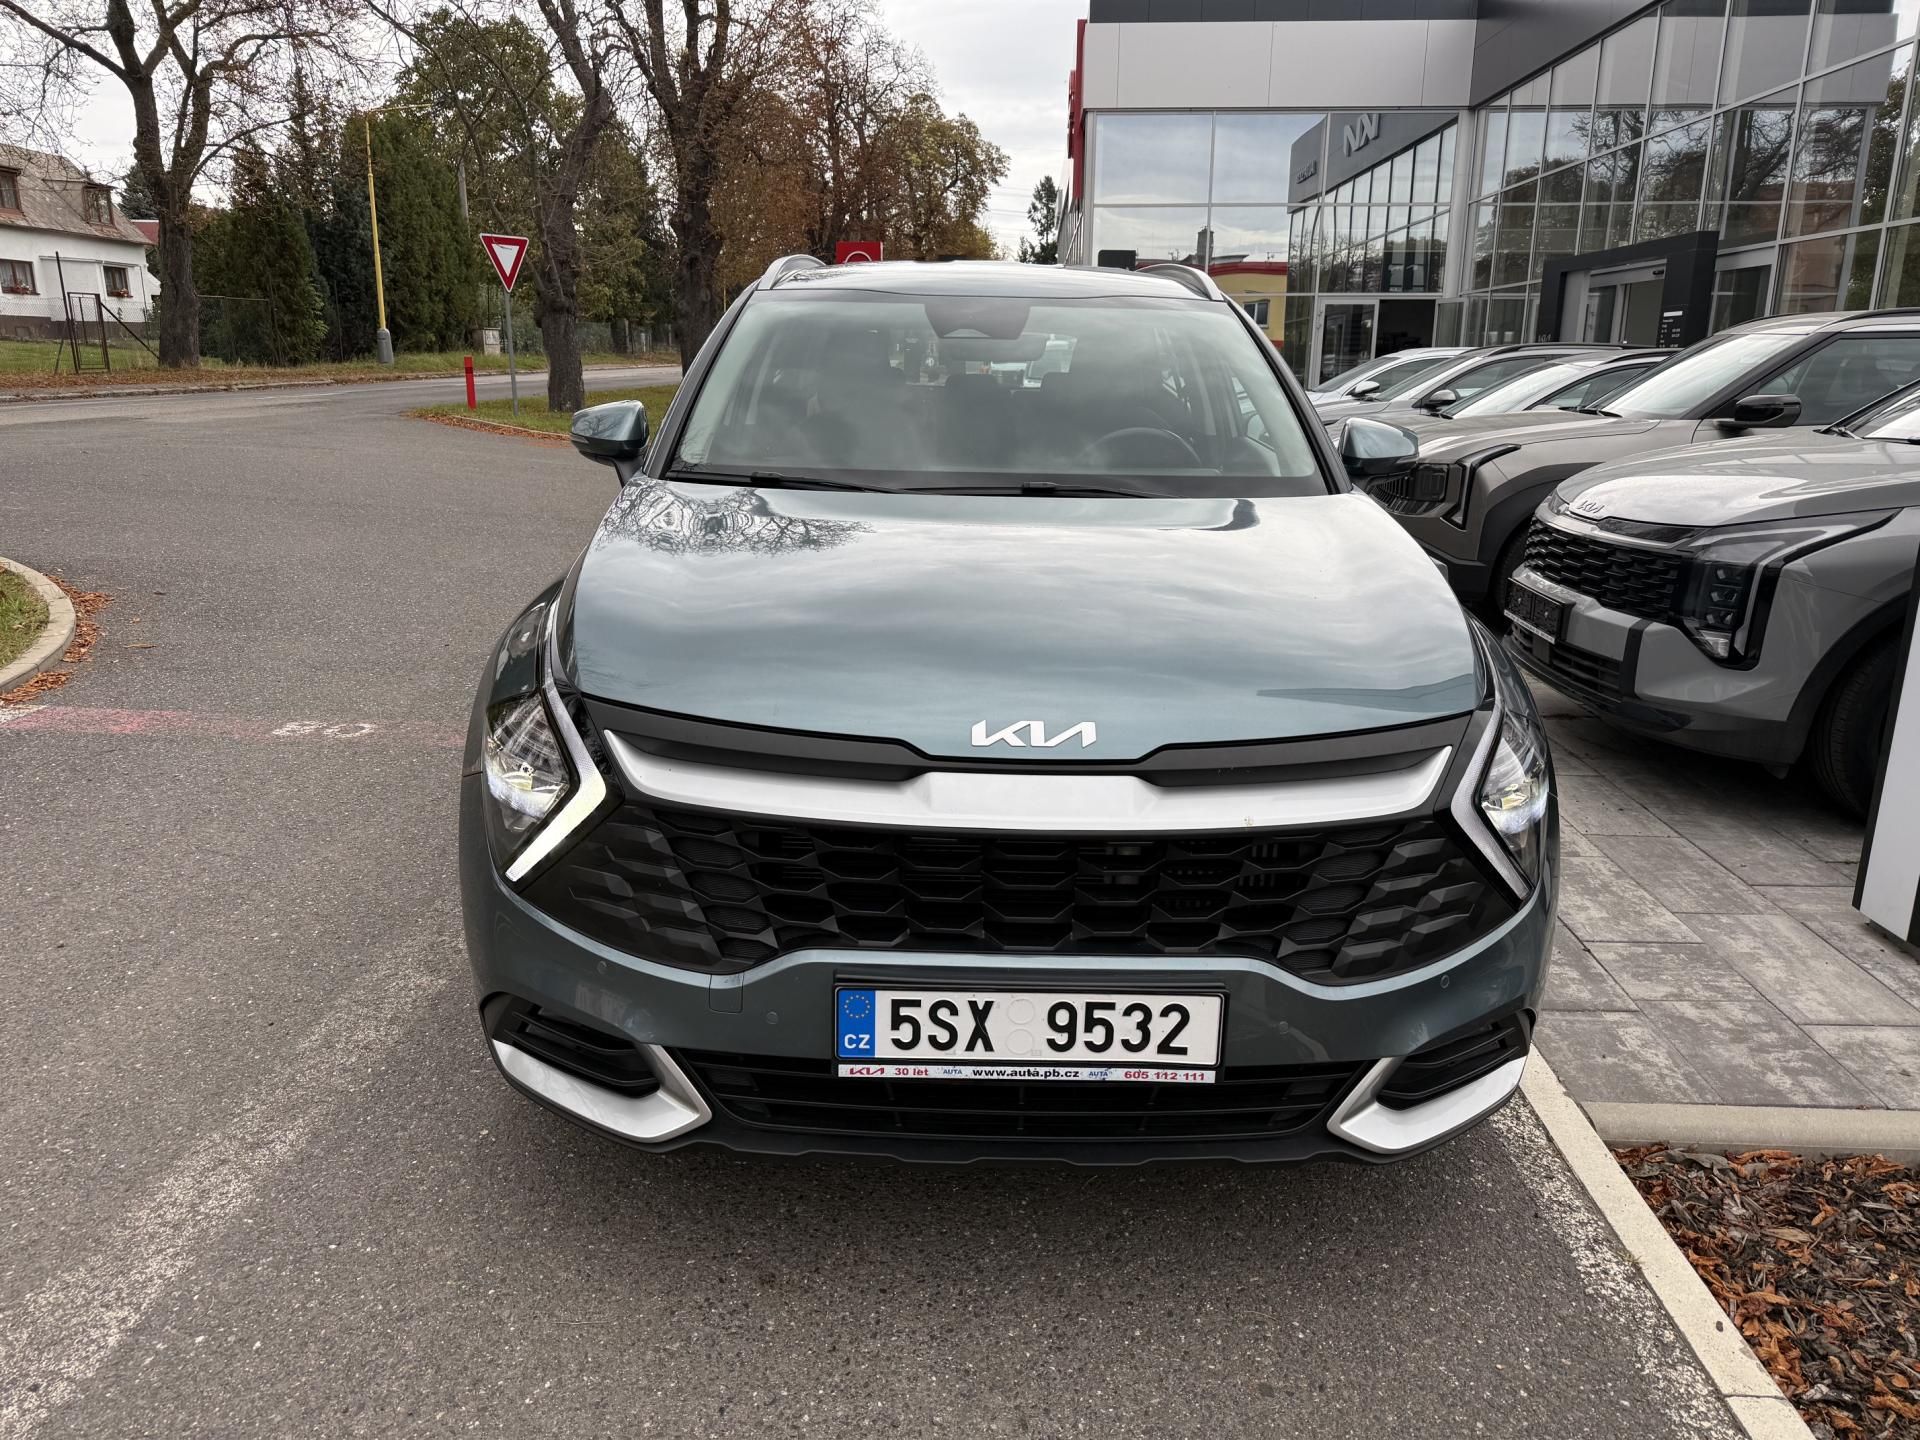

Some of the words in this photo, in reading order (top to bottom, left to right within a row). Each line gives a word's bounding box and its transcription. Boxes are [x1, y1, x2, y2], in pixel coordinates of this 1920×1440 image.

[971, 719, 1097, 748] KIA
[890, 998, 995, 1053] 5SX
[1046, 1001, 1190, 1056] 9532
[844, 1034, 870, 1049] CZ
[850, 1067, 885, 1076] KIA
[895, 1067, 909, 1076] 30
[912, 1068, 929, 1076] let
[1124, 1071, 1149, 1079] 605
[1154, 1072, 1178, 1080] 112
[1183, 1072, 1205, 1081] 111
